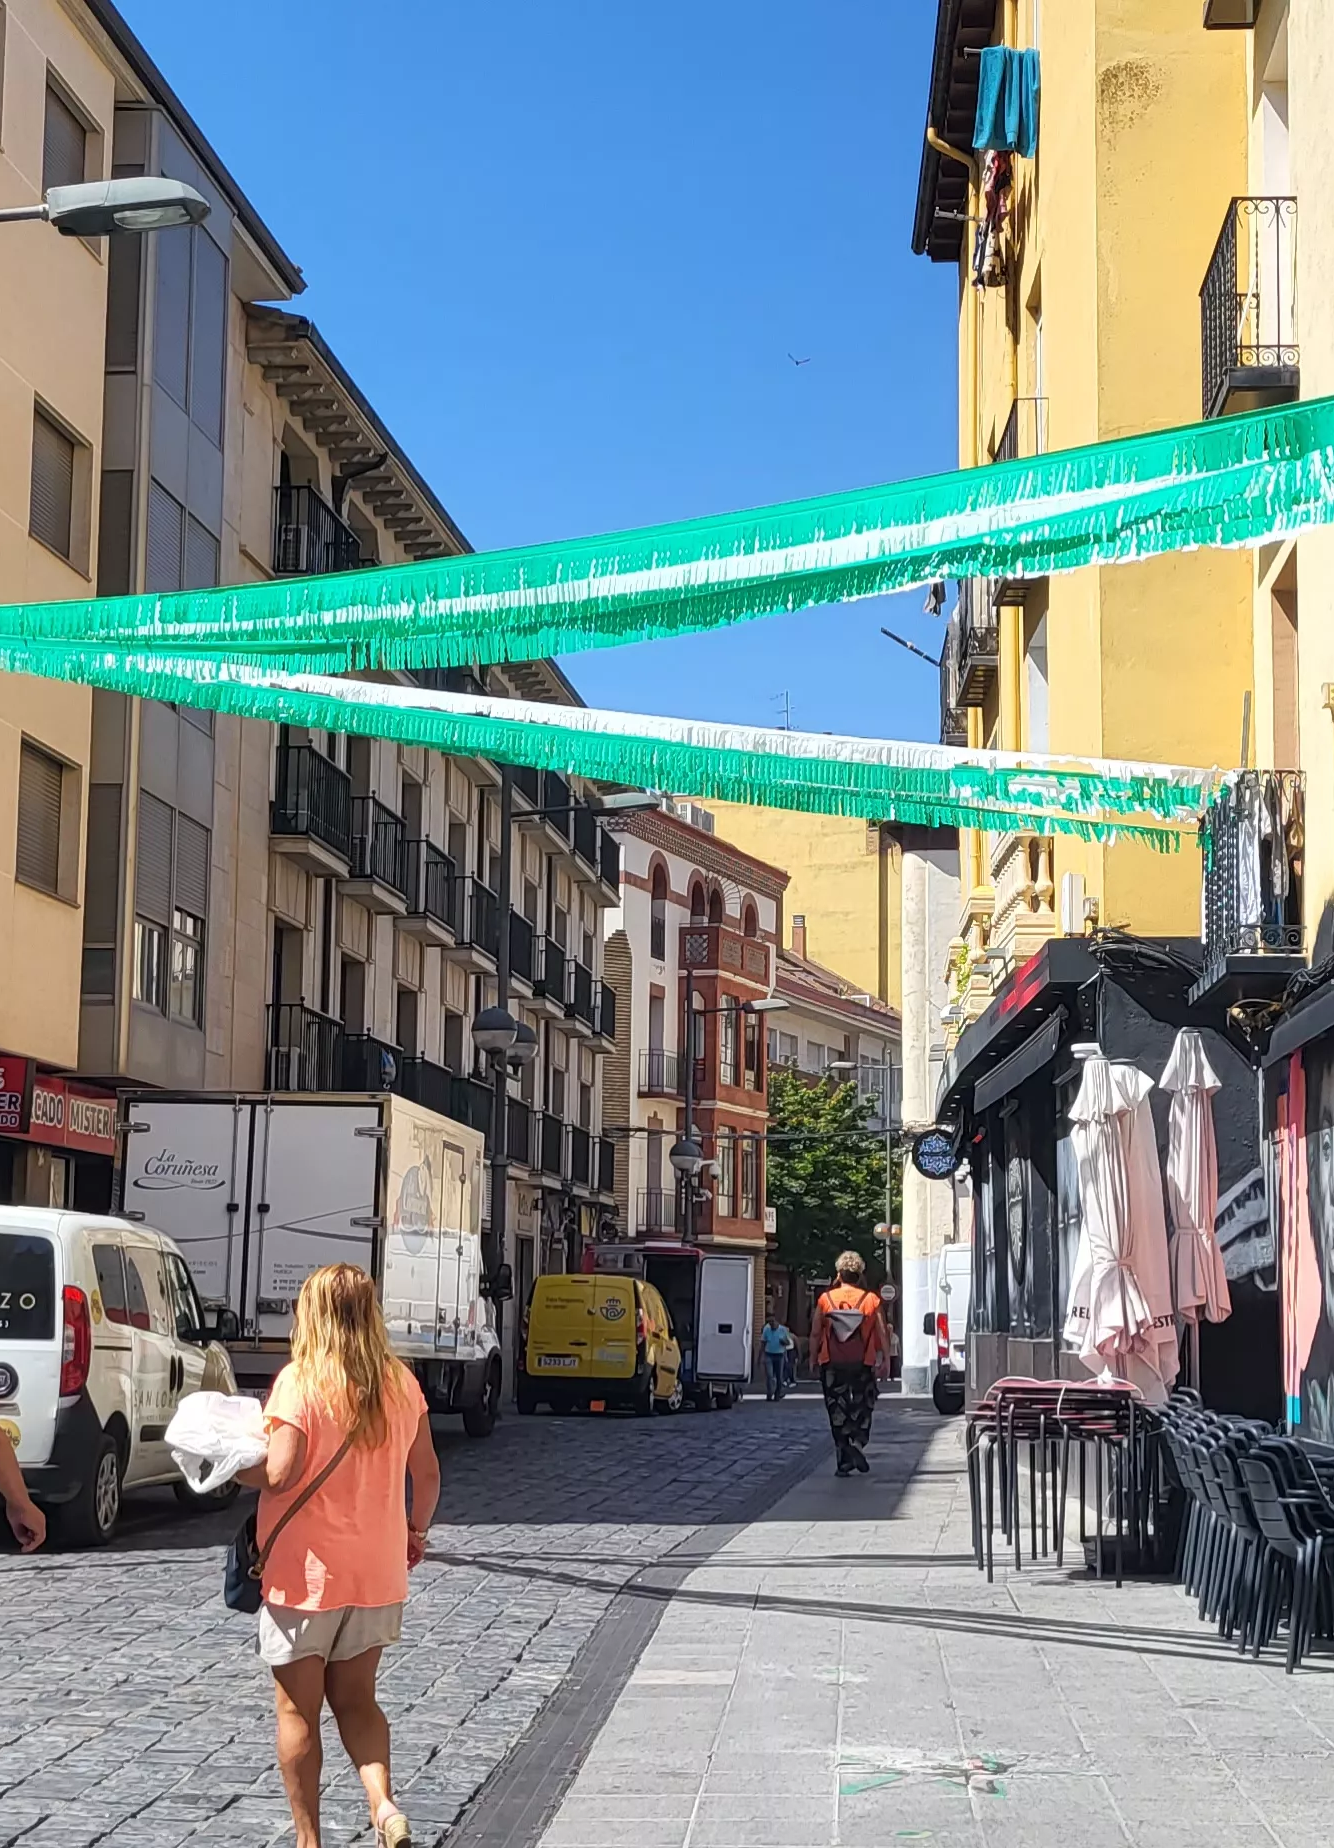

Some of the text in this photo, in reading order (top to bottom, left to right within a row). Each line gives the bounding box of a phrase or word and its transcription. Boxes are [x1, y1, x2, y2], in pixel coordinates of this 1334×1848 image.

[32, 1090, 65, 1128] CADO
[69, 1100, 110, 1139] MISTER
[157, 1149, 175, 1162] La
[144, 1156, 219, 1176] Coruñesa
[134, 1389, 153, 1408] SAN
